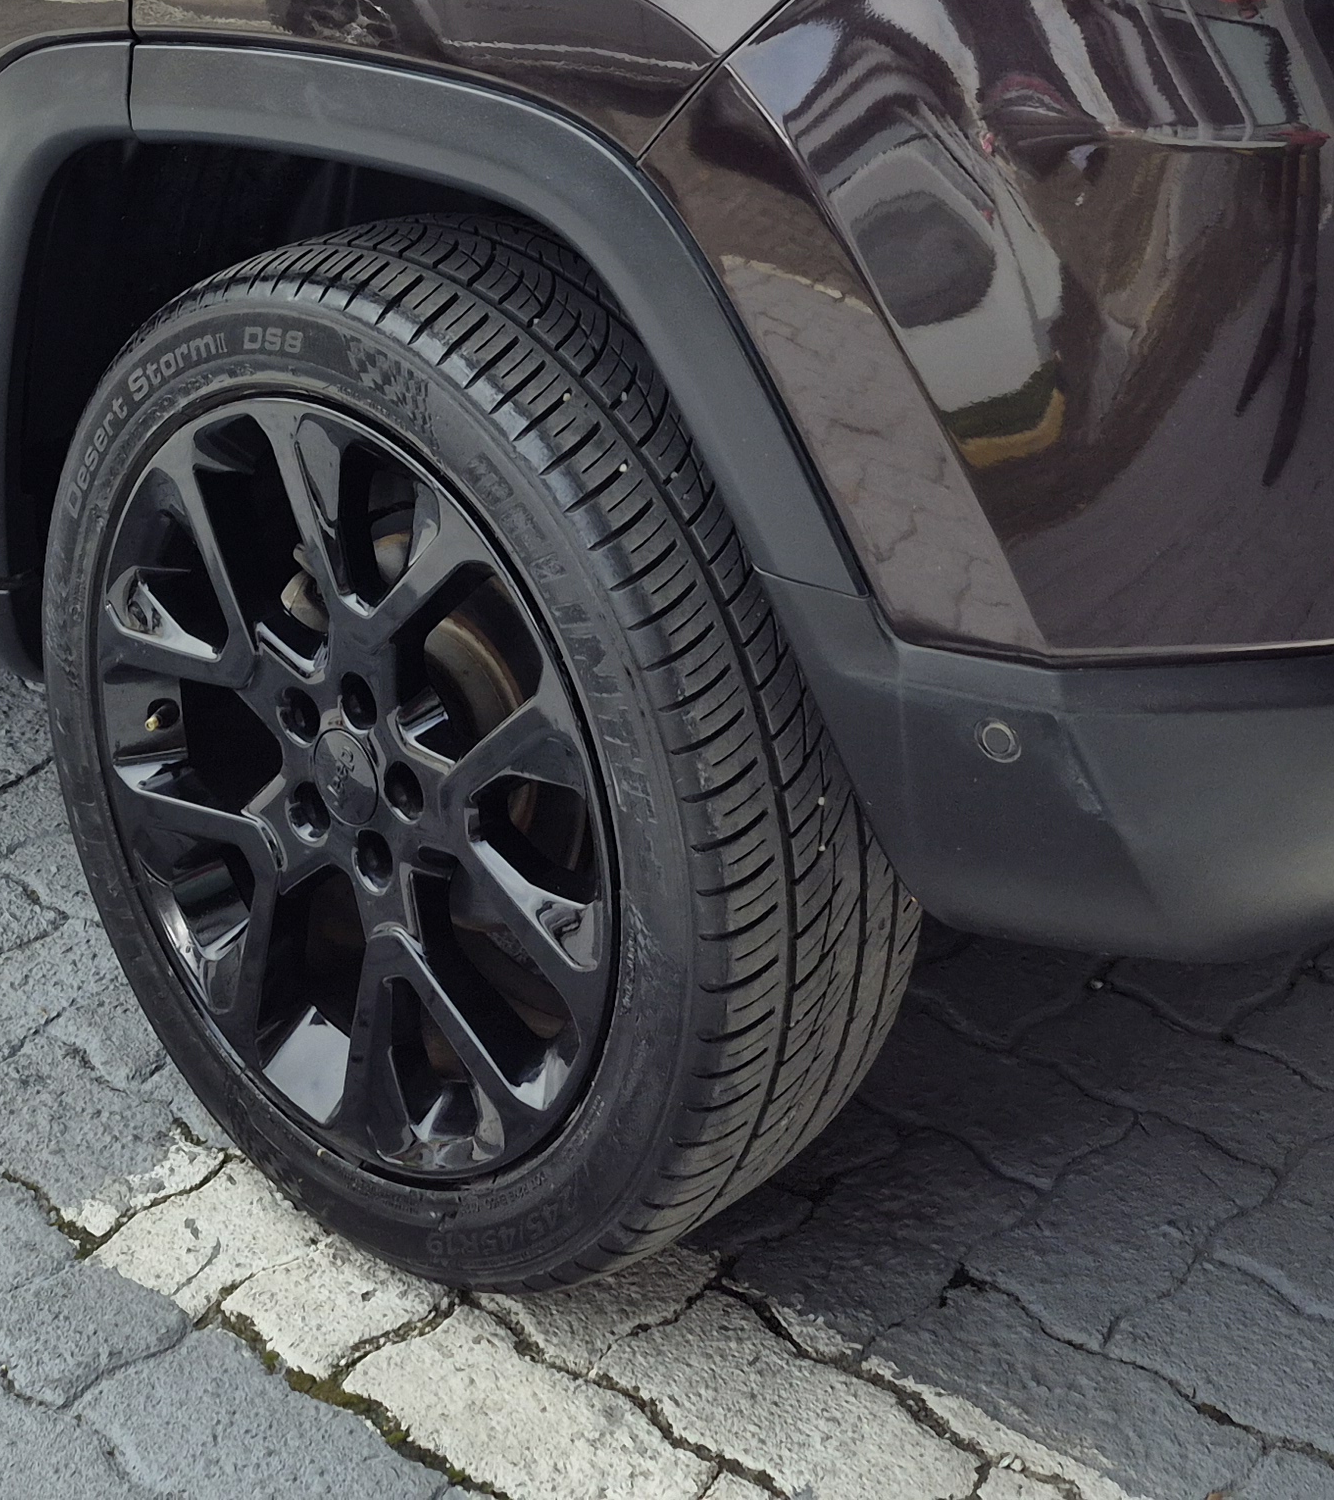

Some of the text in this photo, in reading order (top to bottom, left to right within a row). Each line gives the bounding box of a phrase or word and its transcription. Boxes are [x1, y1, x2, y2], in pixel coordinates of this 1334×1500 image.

[68, 397, 129, 519] Desert
[127, 334, 218, 402] Storm
[243, 326, 304, 354] DS8
